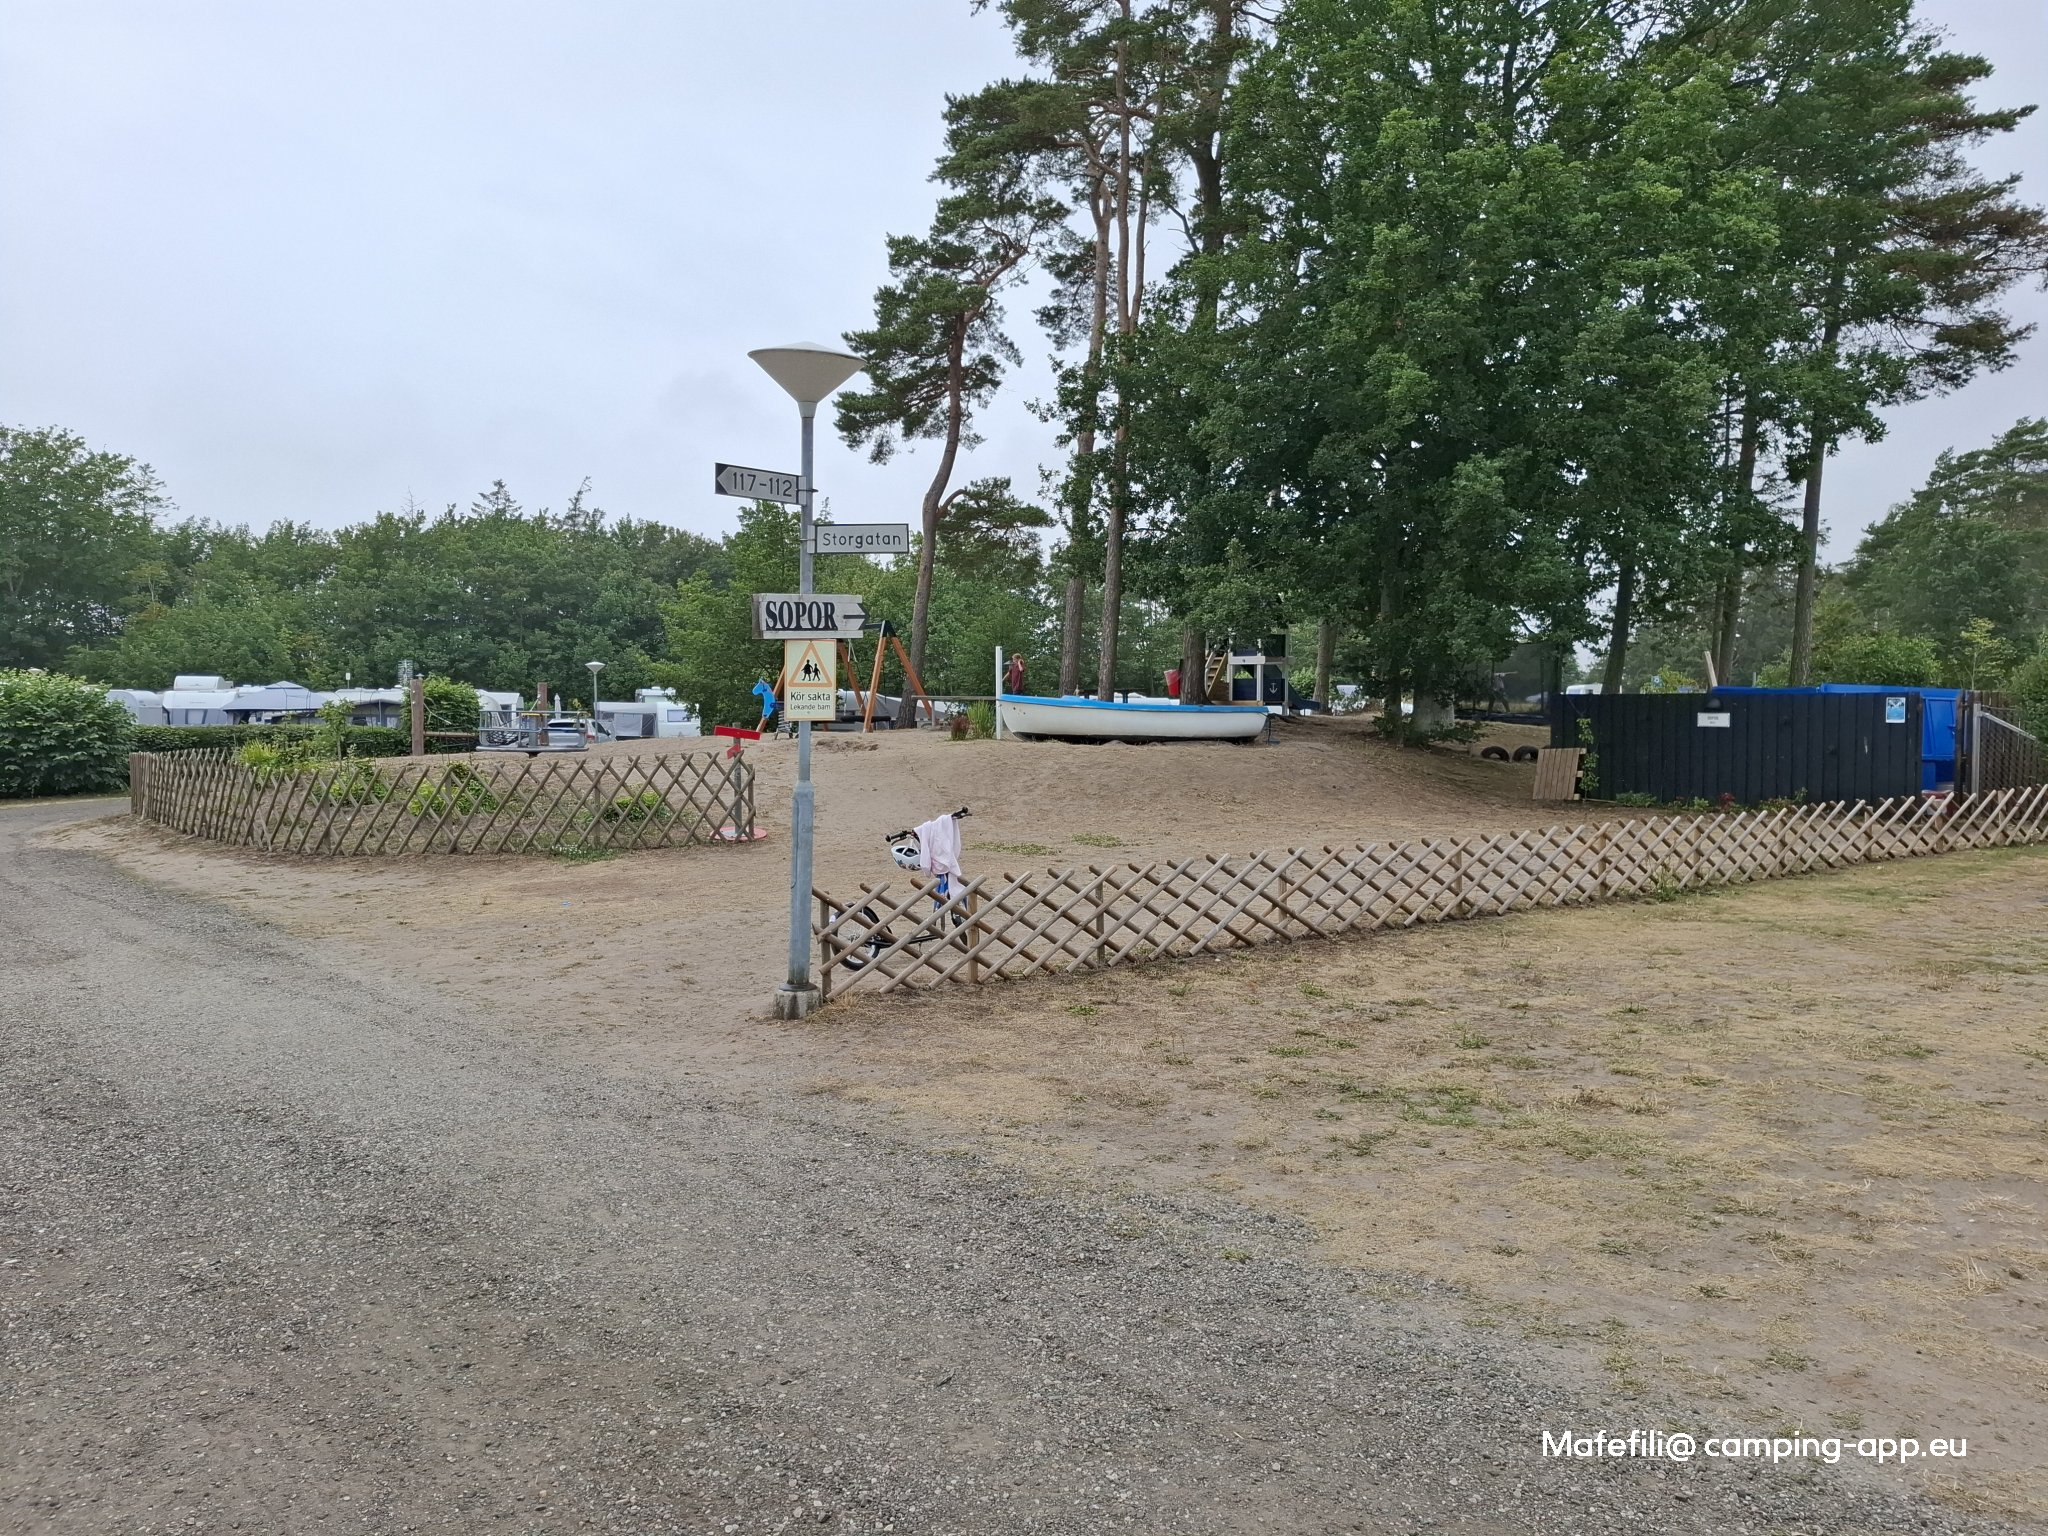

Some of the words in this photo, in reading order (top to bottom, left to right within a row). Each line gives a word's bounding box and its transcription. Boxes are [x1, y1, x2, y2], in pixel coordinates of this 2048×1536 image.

[732, 471, 792, 497] 117-112
[822, 532, 901, 549] Storgatan
[765, 600, 838, 631] SOPOR
[790, 691, 805, 701] Kör
[807, 692, 831, 701] sakta
